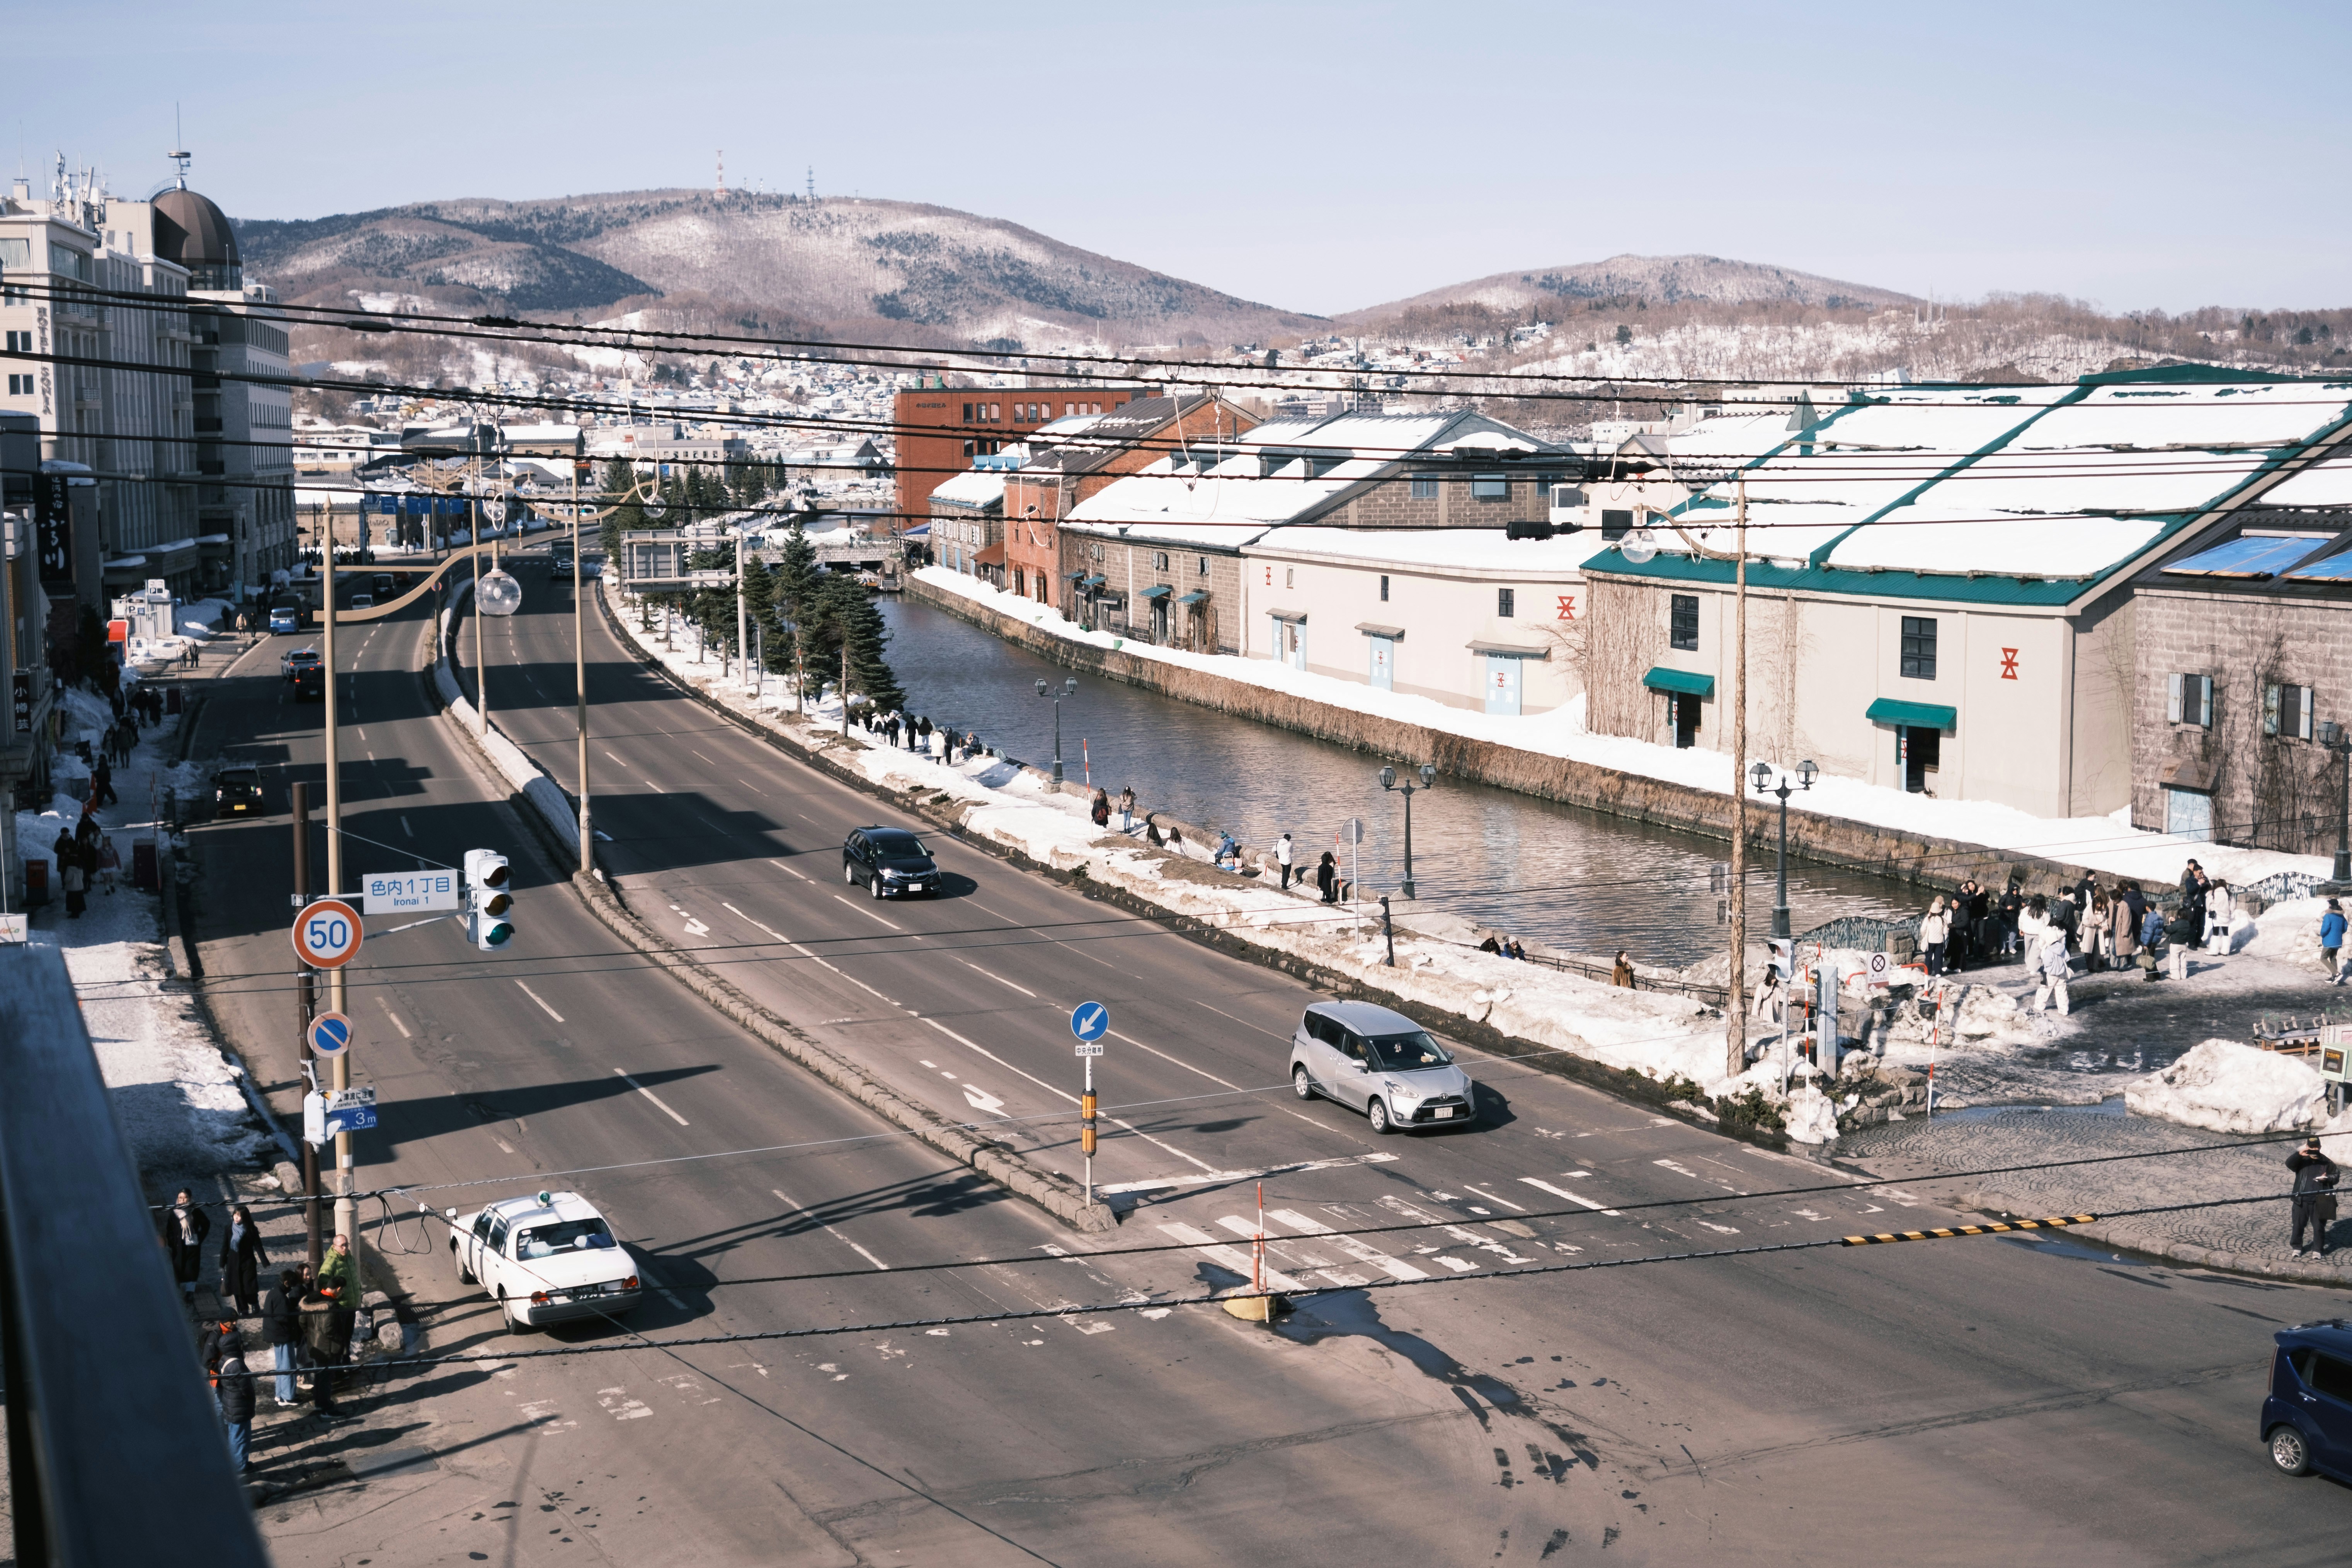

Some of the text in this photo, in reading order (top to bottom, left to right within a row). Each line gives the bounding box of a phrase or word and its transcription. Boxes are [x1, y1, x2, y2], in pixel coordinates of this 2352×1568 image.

[40, 366, 53, 415] SONIA
[41, 512, 65, 569] ふる川
[371, 877, 449, 896] 色内1丁目
[394, 896, 429, 906] Ironai 1
[310, 919, 346, 949] 50
[338, 1090, 374, 1102] 津波に注意
[356, 1112, 365, 1125] 3
